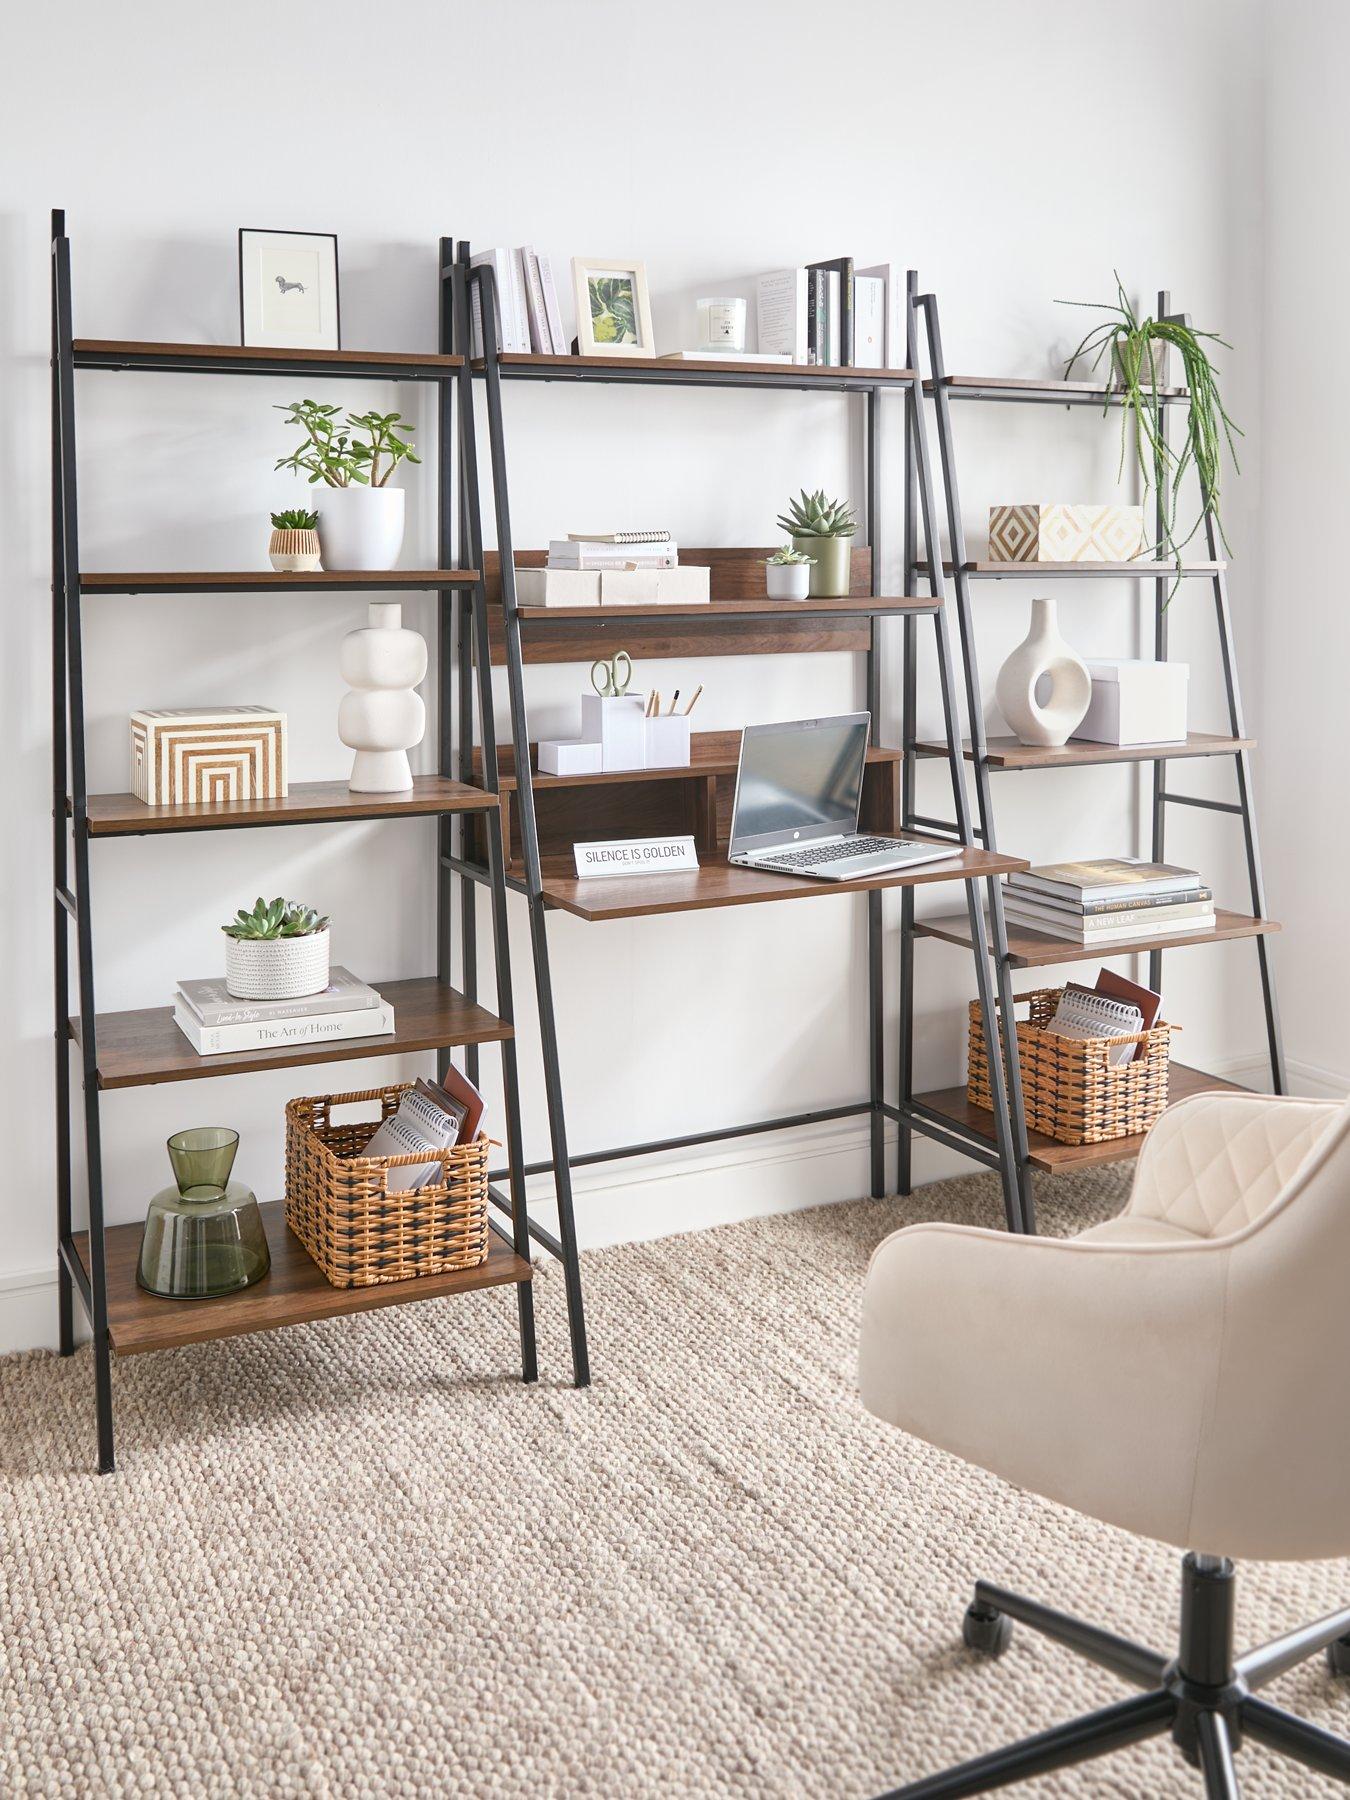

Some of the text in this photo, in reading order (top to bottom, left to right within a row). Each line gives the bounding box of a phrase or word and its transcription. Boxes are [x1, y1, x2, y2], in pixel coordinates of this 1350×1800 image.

[585, 845, 685, 863] SILENCE IS GOLDEN
[1094, 904, 1104, 912] THE
[1106, 902, 1128, 911] HUMAN
[1128, 899, 1151, 909] CANVAS
[1088, 914, 1136, 928] A NEW LEAF
[257, 1022, 343, 1040] The Art of Home
